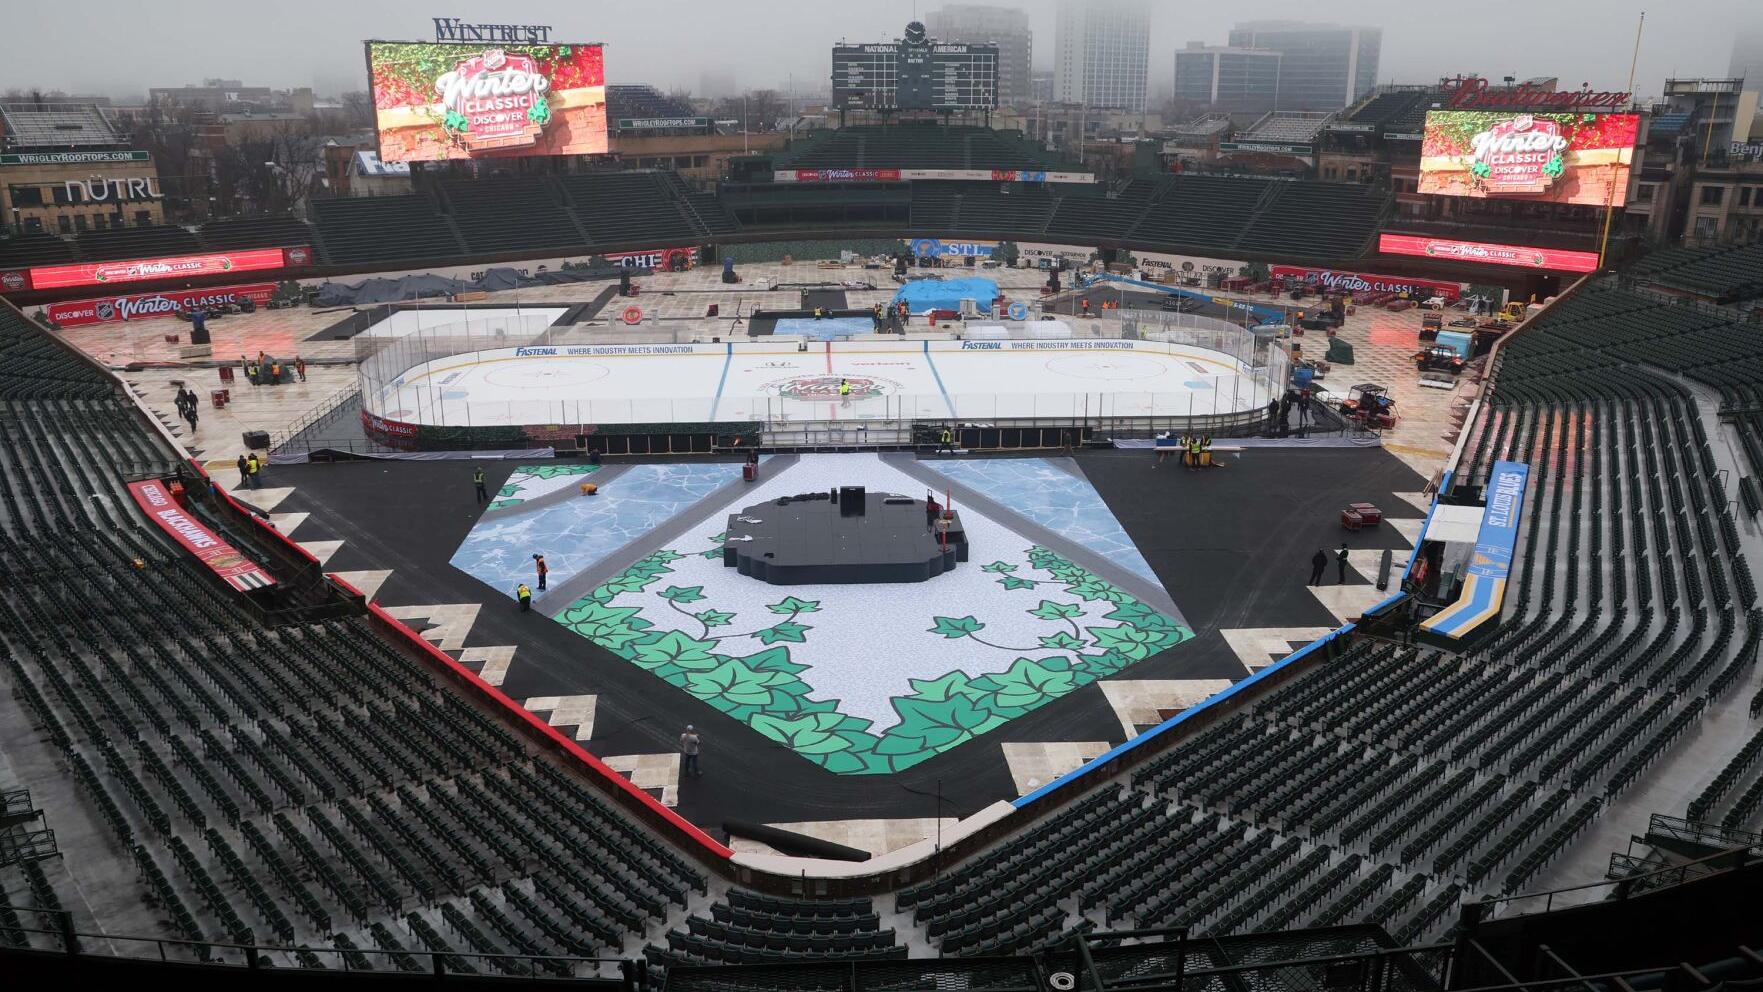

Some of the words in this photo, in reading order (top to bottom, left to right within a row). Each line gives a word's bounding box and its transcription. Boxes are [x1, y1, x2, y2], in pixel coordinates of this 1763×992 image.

[433, 18, 552, 42] WINTRUST
[864, 45, 898, 53] NATIONAL
[933, 45, 967, 53] AMERICAN
[436, 70, 549, 105] Winter
[1443, 77, 1632, 107] Budweiser
[466, 97, 530, 113] CLASSIC
[473, 112, 524, 125] DISCOVER
[1472, 131, 1567, 158] Winter
[18, 151, 133, 163] WRIGLEYROOFTOPS.COM
[1491, 152, 1546, 164] CLASSIC
[1494, 166, 1539, 175] DISCOVER
[948, 244, 984, 256] STL
[1024, 249, 1054, 257] DISCOVER
[1490, 250, 1517, 258] CLASSIC
[621, 255, 656, 269] CHI
[1141, 258, 1173, 269] FASTENAL
[137, 263, 173, 276] Winter
[173, 262, 203, 271] CLASSIC
[1202, 264, 1234, 275] DISCOVER
[1320, 272, 1371, 292] Winter
[1374, 283, 1420, 294] CLASSI
[55, 309, 94, 321] DISCOVER
[114, 295, 182, 322] Winter
[183, 293, 236, 308] CLASSIC
[516, 346, 558, 356] FASTENAL
[568, 347, 591, 355] WHERE
[593, 347, 626, 355] INDUSTRY
[628, 346, 651, 354] MEETS
[653, 346, 694, 354] INNOVATION
[961, 340, 1002, 350] FASTENAL
[1011, 342, 1035, 350] WHERE
[1036, 342, 1069, 350] INDUSTRY
[1071, 342, 1092, 350] MEETS
[389, 425, 413, 434] CLASSIC
[1496, 473, 1520, 495] BLUES
[1490, 494, 1513, 516] LOUIS
[141, 484, 169, 507] CHICAGO
[157, 509, 219, 548] BLACKHAWKS
